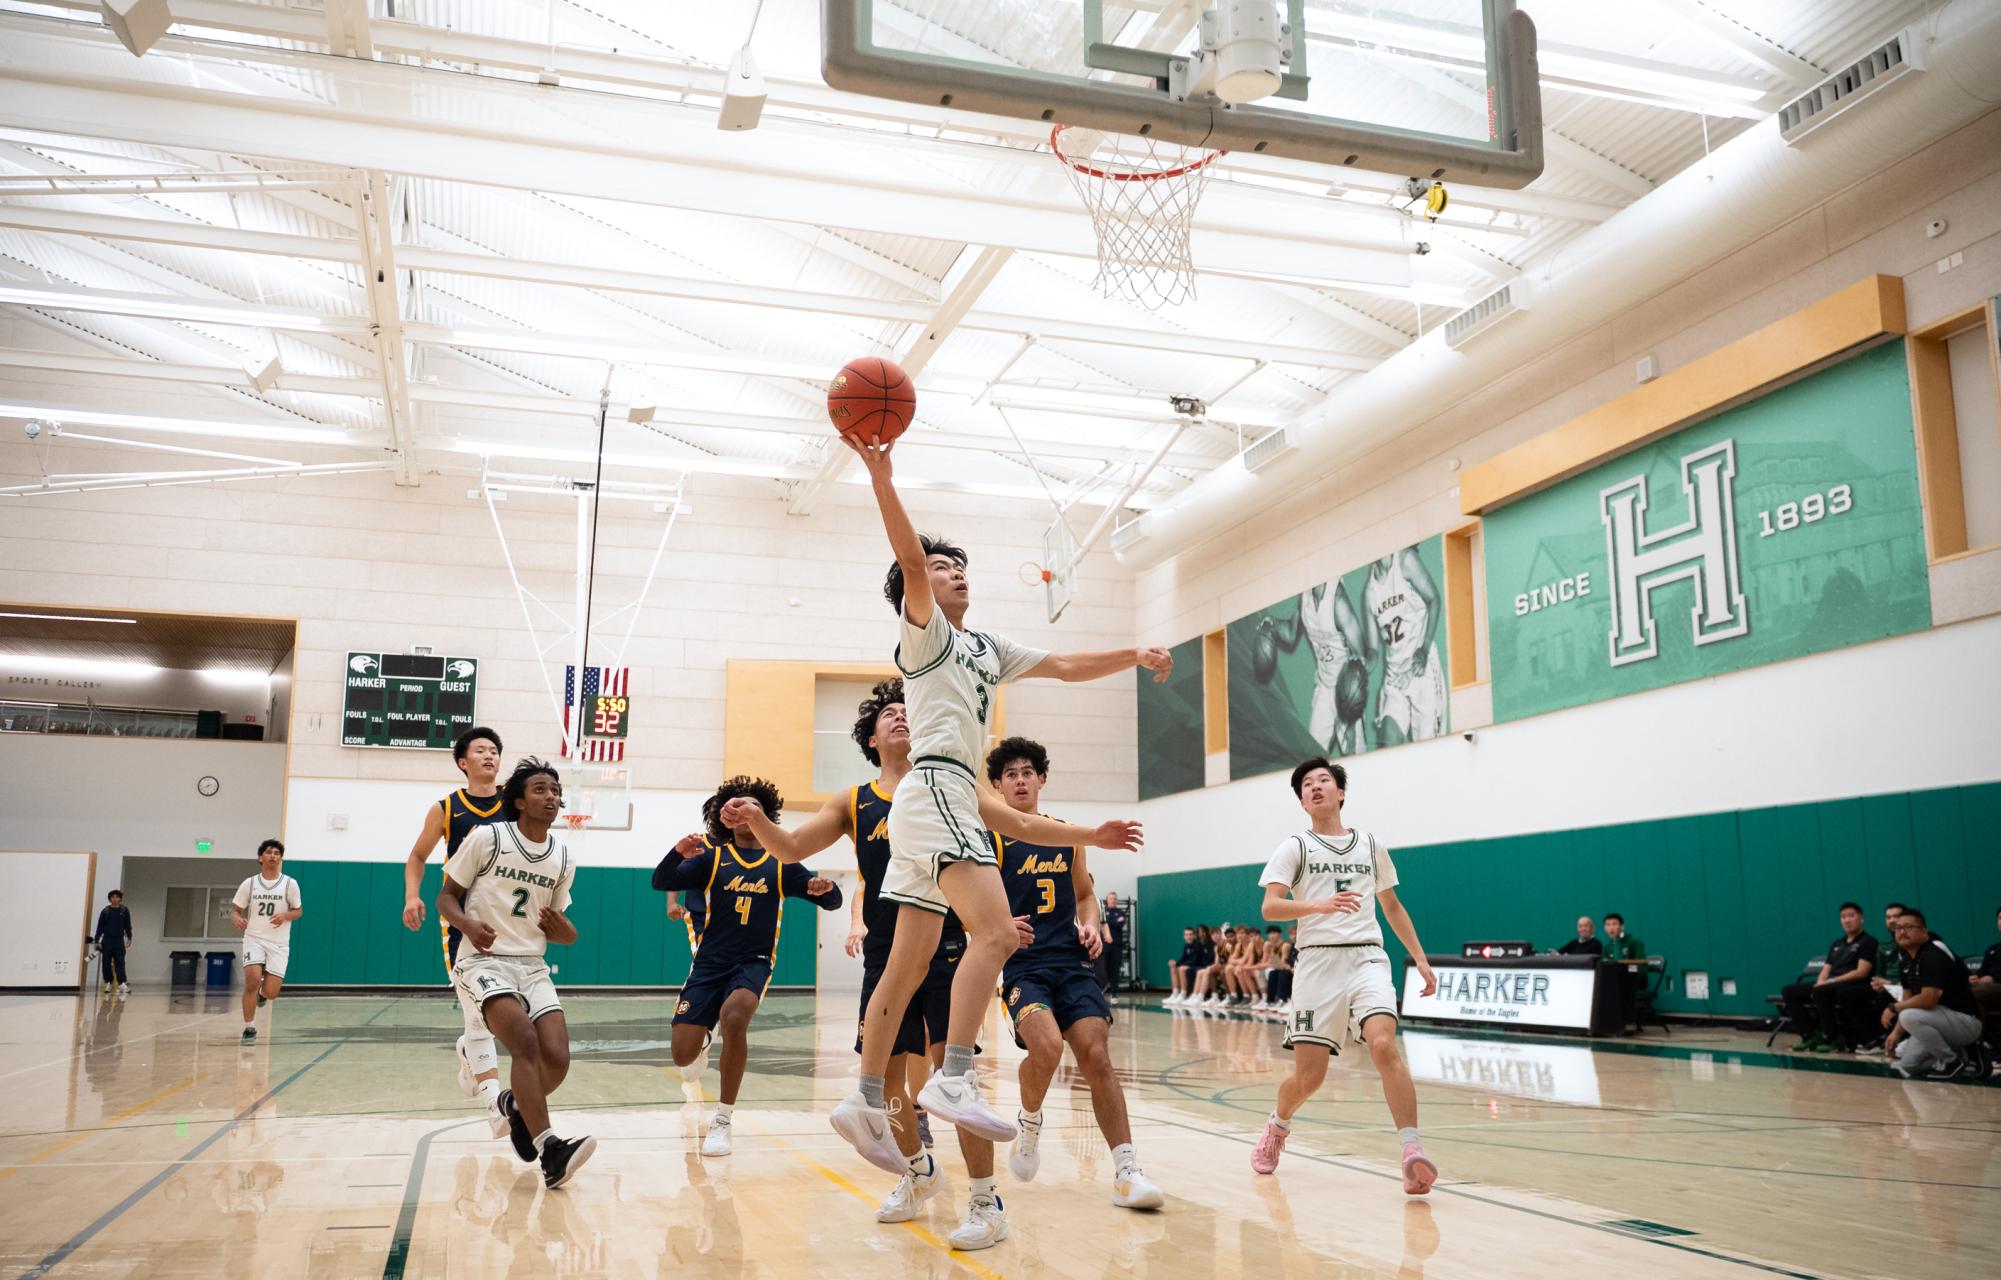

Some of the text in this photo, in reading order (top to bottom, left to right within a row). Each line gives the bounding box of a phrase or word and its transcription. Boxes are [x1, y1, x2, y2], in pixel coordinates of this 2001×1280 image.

[1758, 484, 1852, 537] 1893
[1600, 437, 1748, 666] H
[1377, 593, 1405, 615] ARKER
[1514, 572, 1591, 616] SINCE
[348, 677, 471, 692] HARKER GUEST
[400, 684, 423, 692] PERIOD
[597, 697, 627, 713] 5:50
[975, 683, 990, 726] 3
[346, 710, 472, 723] FOULS FOUL PLAYER FOULS
[594, 710, 620, 734] 32
[390, 739, 426, 747] ADVANTAGE
[1017, 853, 1068, 875] Menlo
[1309, 862, 1371, 876] HARKER
[494, 866, 556, 889] HARKER
[724, 875, 769, 893] Menlo
[511, 886, 531, 919] 2
[1036, 878, 1056, 914] 3
[258, 902, 275, 916] 20
[734, 896, 752, 926] 4
[1436, 971, 1550, 1006] HARKER
[1295, 1010, 1315, 1032] H
